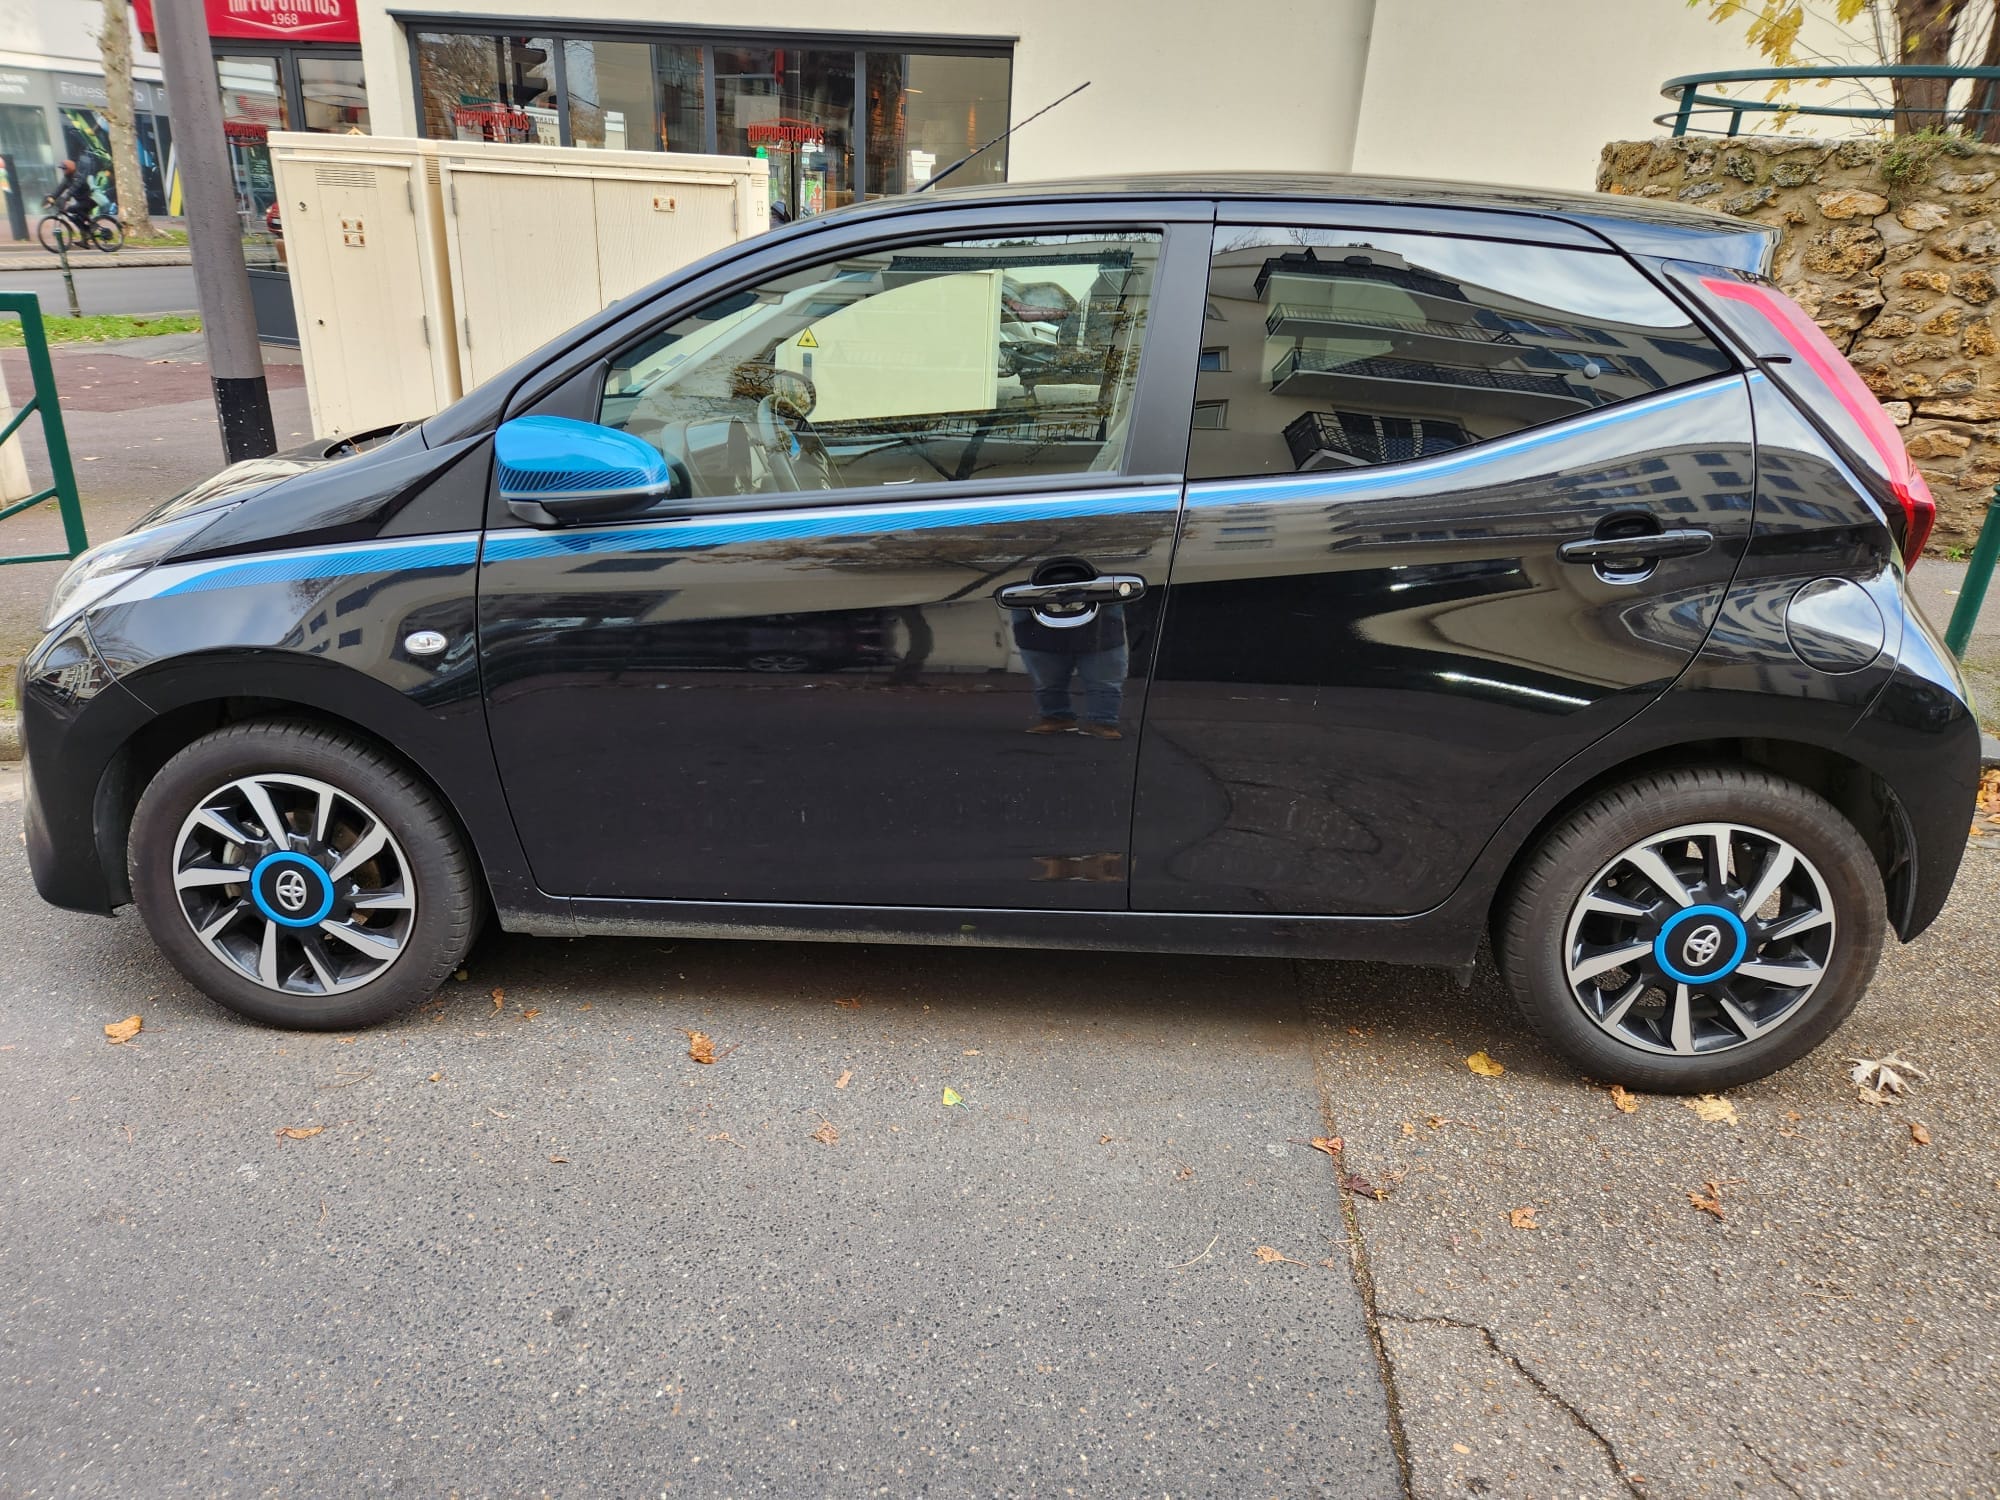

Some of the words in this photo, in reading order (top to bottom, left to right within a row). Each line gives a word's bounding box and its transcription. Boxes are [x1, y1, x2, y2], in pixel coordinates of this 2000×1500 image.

[271, 13, 299, 25] 1968
[455, 107, 529, 131] HIPPOPOTAMUS
[748, 125, 825, 145] HIPPOPOTAMUS
